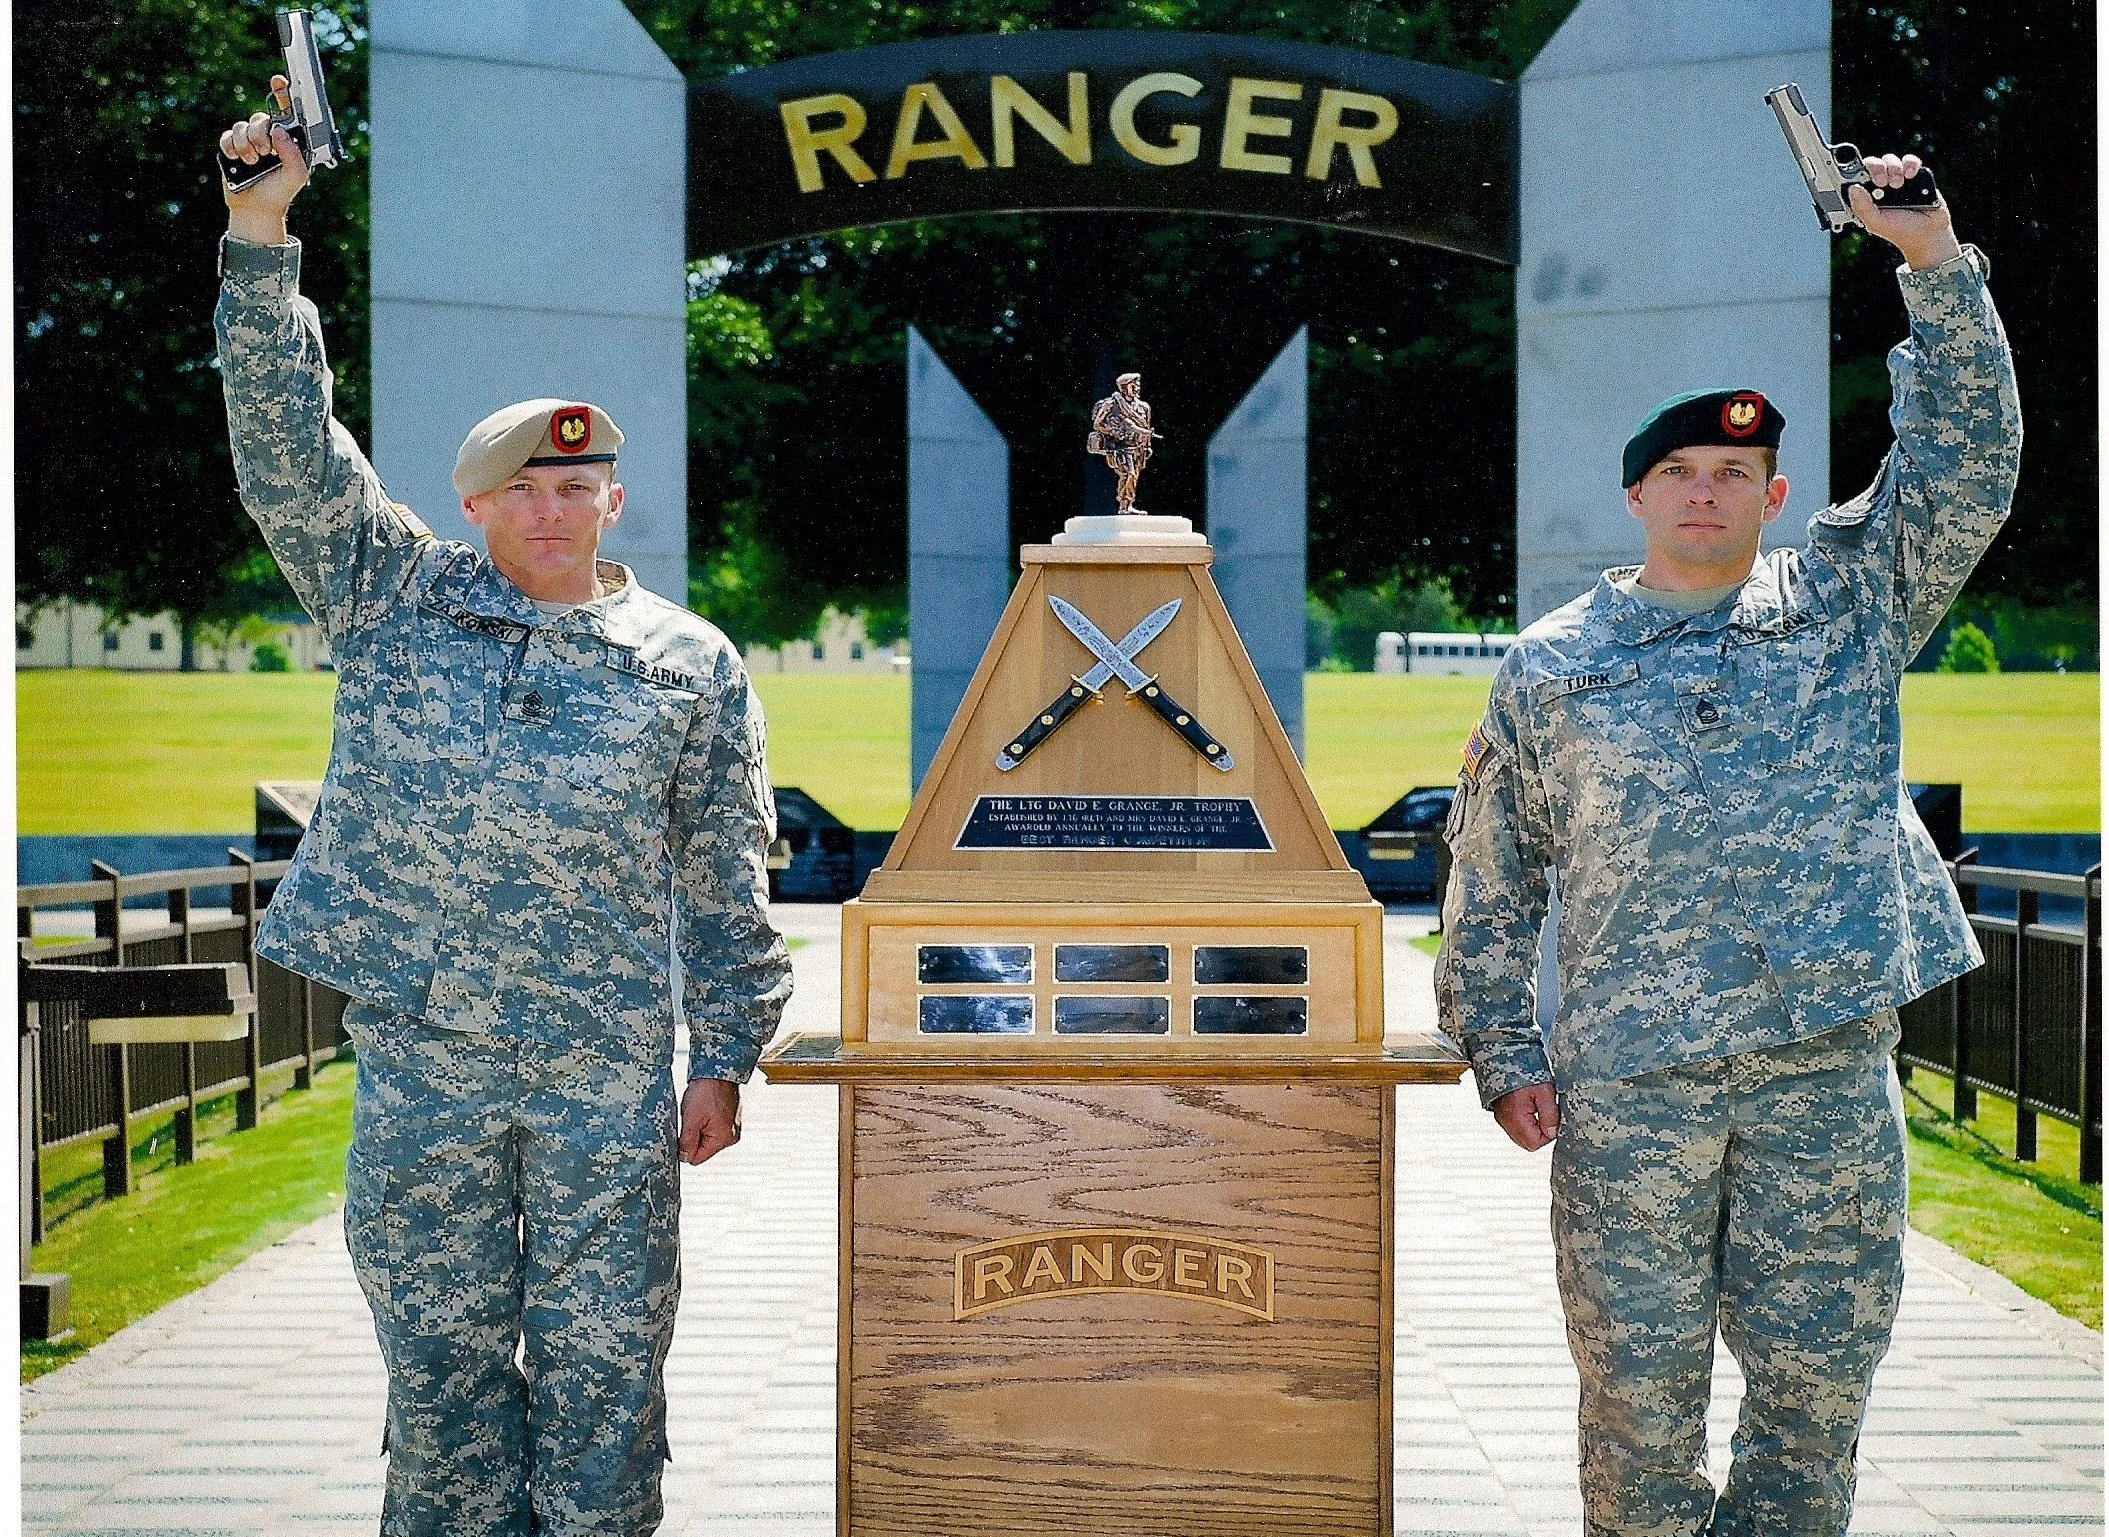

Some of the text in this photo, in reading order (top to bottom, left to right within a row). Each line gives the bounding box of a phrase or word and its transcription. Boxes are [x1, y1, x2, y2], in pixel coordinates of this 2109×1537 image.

[779, 71, 1399, 193] RANGER
[1563, 672, 1611, 691] TURK
[988, 800, 1013, 811] THE
[1019, 800, 1042, 811] LTG
[1048, 800, 1088, 811] DAVID
[1193, 802, 1242, 812] TROPHY
[988, 813, 1044, 821] ESTABLISHED
[1106, 814, 1125, 822] AND
[1149, 815, 1177, 823] DAVID
[1004, 823, 1052, 831] AWARDED
[1055, 823, 1106, 831] ANNUALLY
[1111, 824, 1123, 832] TO
[1127, 824, 1145, 832] THE
[1148, 824, 1191, 833] WINNERS
[973, 1242, 1256, 1301] RANGER
